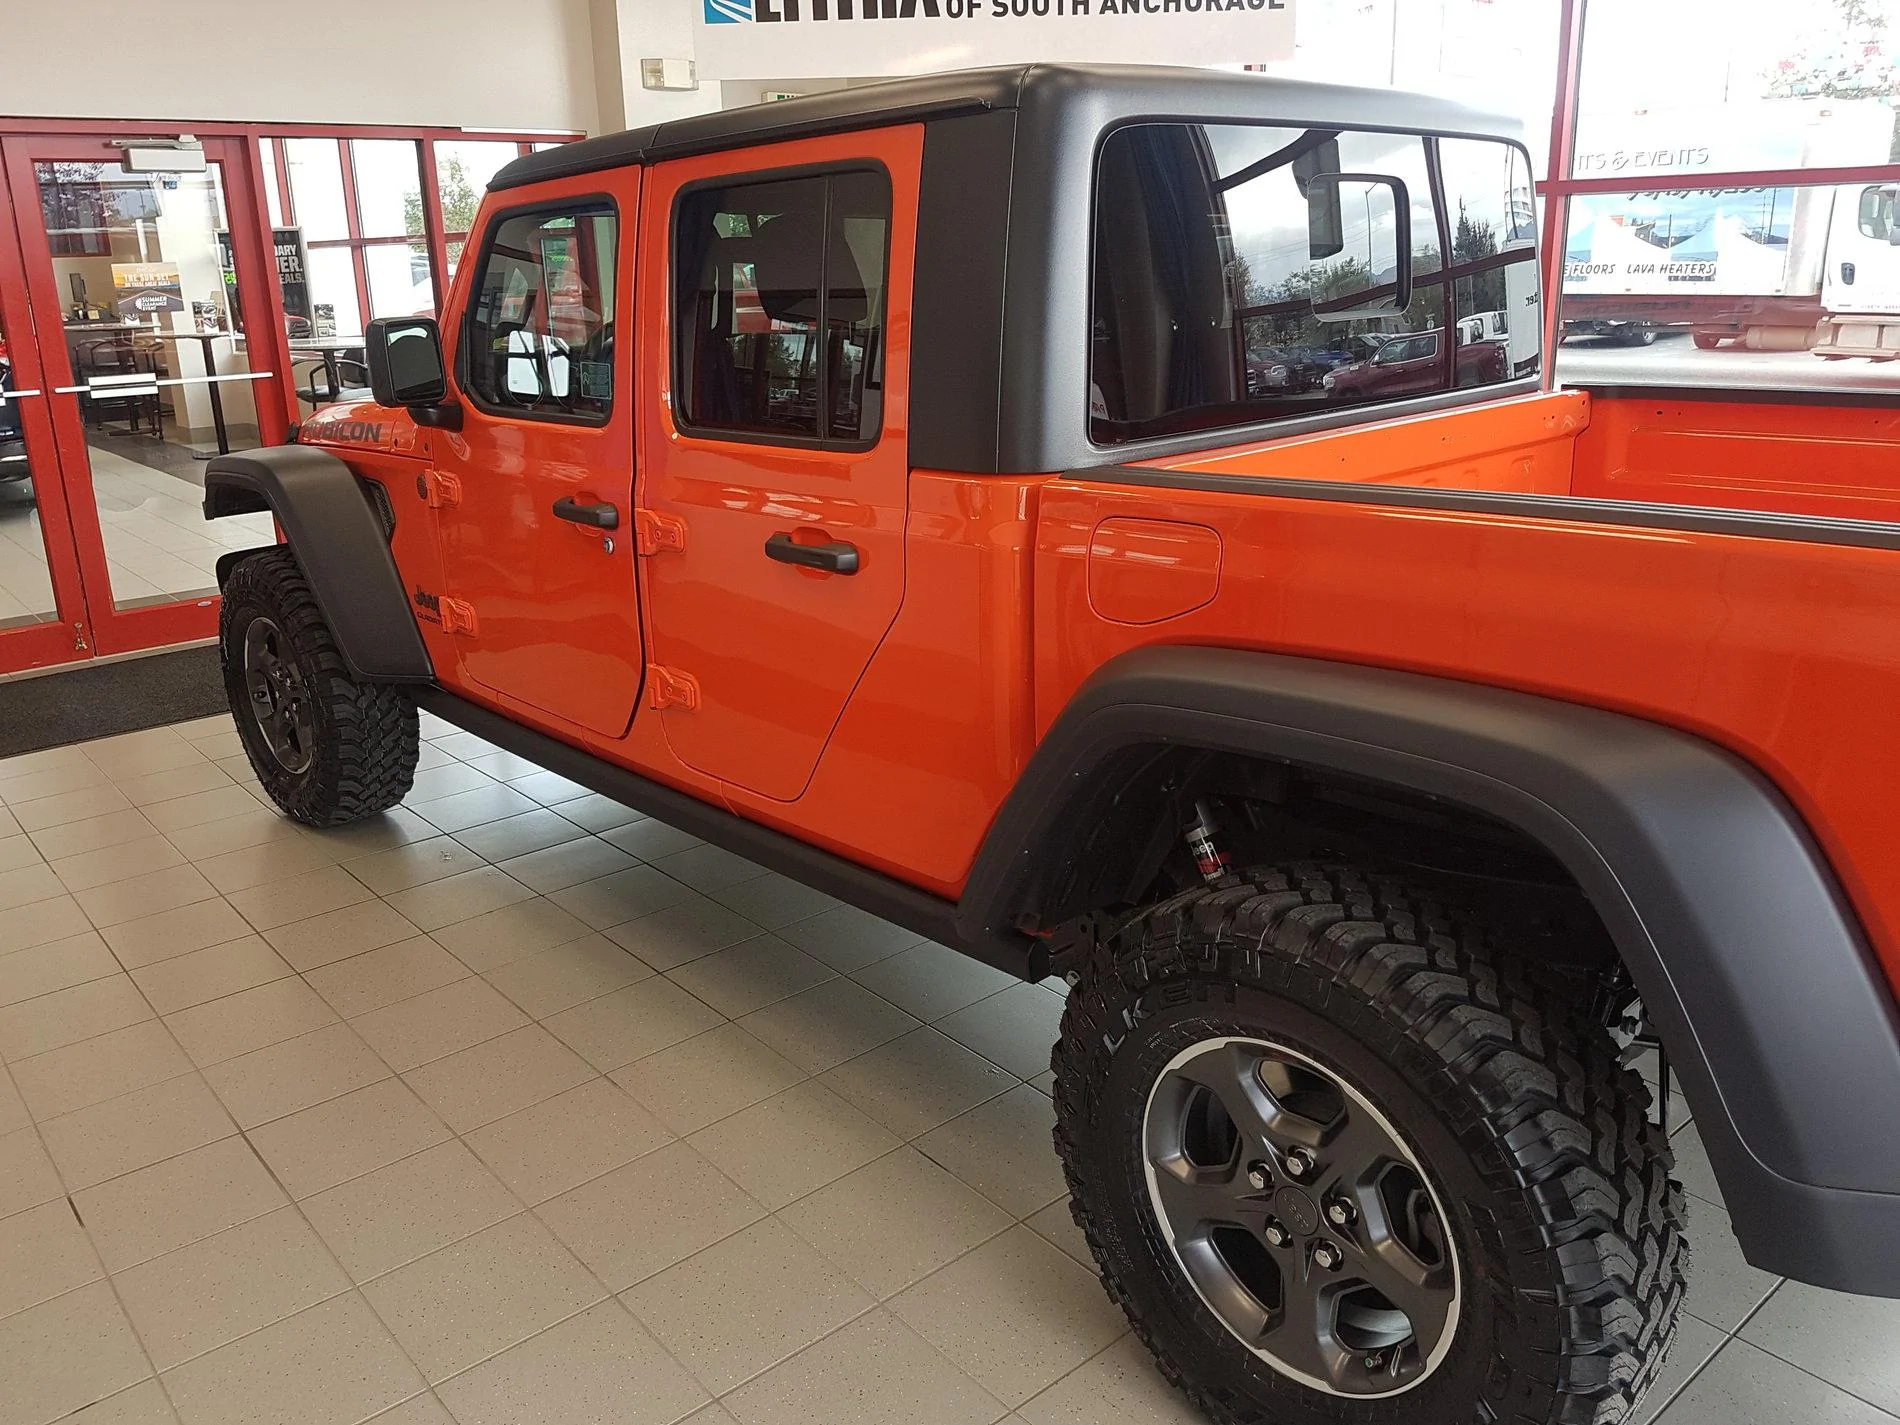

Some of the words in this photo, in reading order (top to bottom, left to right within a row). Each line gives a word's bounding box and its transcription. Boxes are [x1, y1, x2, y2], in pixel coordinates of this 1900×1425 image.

[991, 0, 1090, 17] SOUTH
[1573, 264, 1616, 275] FLOORS
[1627, 264, 1655, 274] LAVA
[1659, 263, 1715, 274] HEATERS
[302, 421, 382, 443] RUBICON
